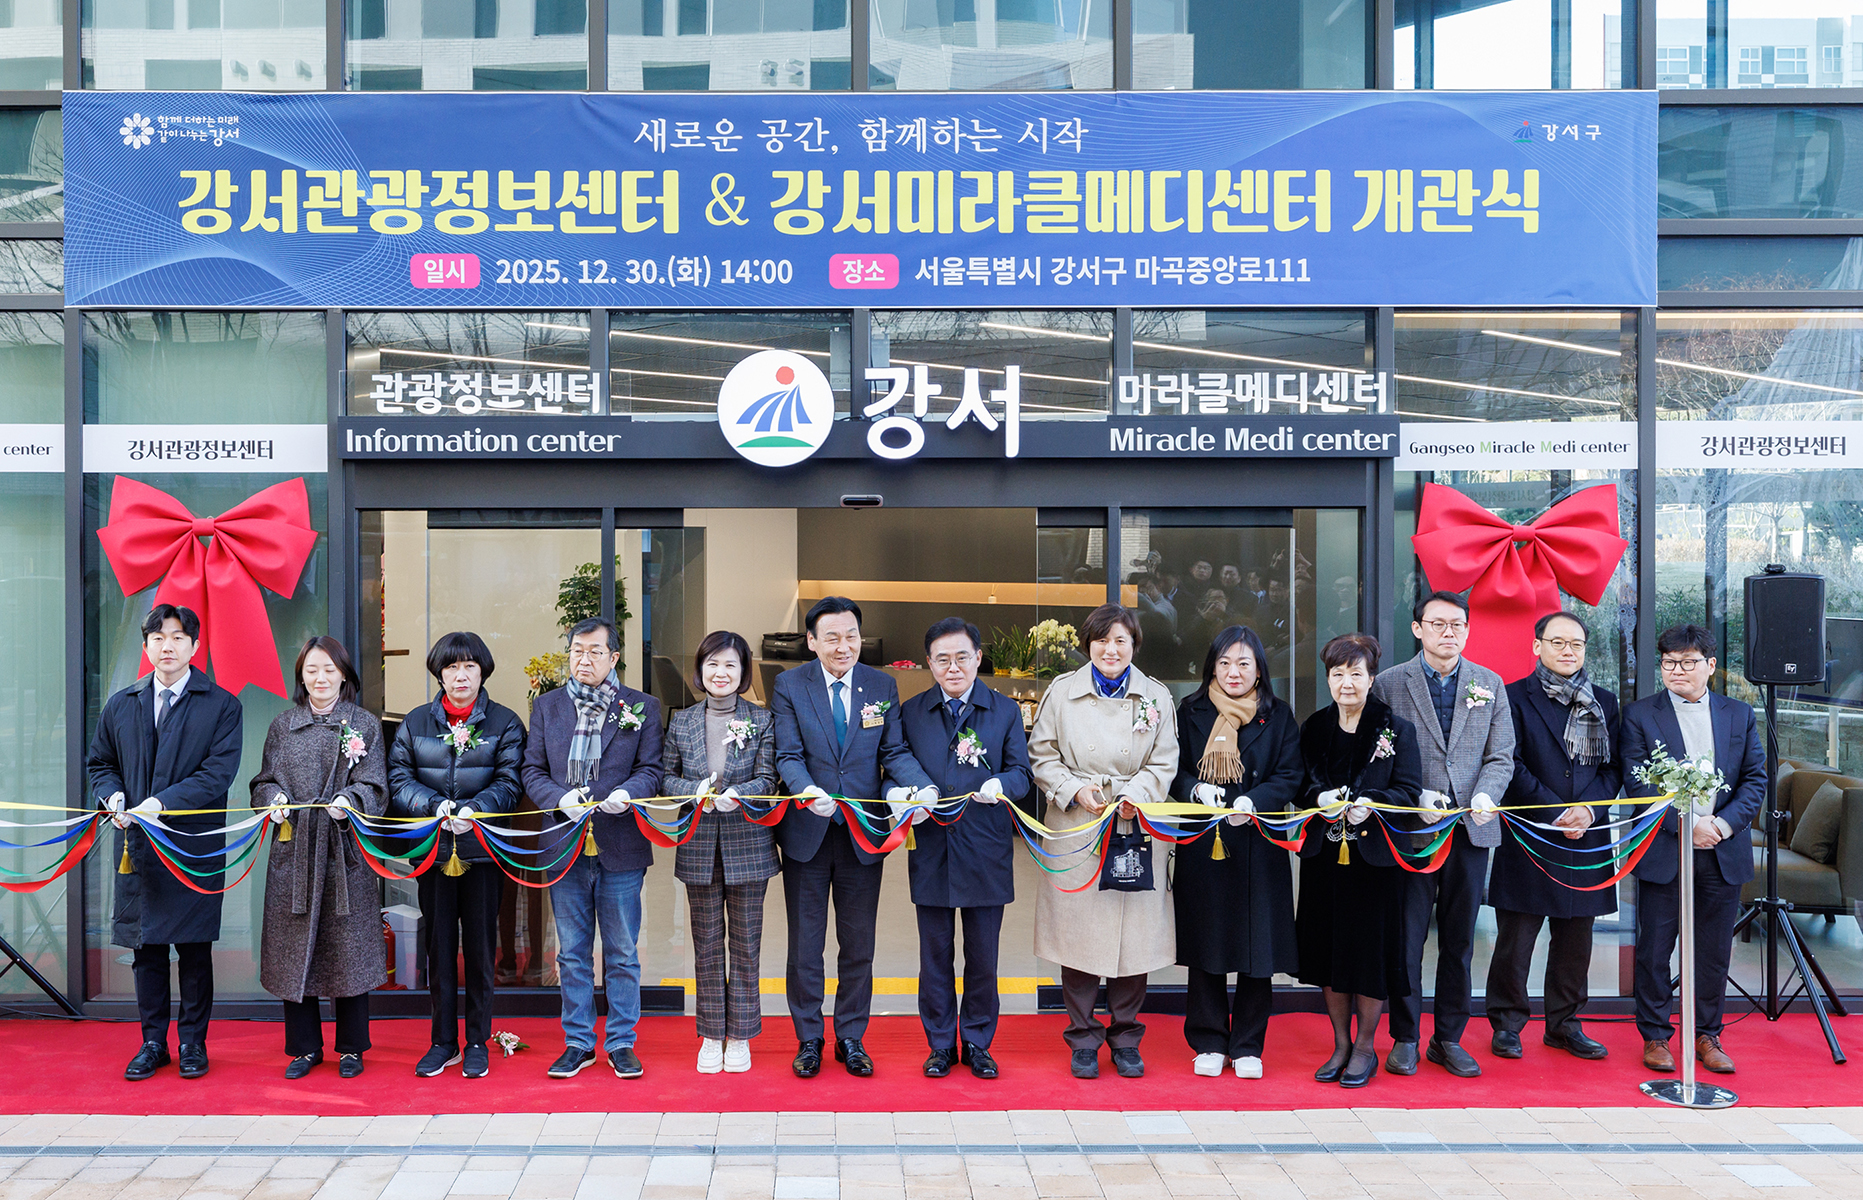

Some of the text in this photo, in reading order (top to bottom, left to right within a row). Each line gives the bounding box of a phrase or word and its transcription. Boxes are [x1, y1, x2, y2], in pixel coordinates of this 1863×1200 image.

[157, 115, 239, 129] 함께 더하는 미래
[157, 128, 240, 147] 같이 나누는 강서
[633, 116, 1090, 155] 새로운 공간, 함께하는 시작
[178, 169, 1540, 235] 강서관광정보센터 & 강서미라클메디센터 개관식
[423, 258, 466, 284] 일시
[495, 258, 568, 285] 2025.
[578, 259, 618, 285] 12.
[720, 259, 793, 285] 14:00
[842, 258, 886, 285] 장소
[914, 255, 1312, 287] 서울특별시 강서구 마곡중앙로111
[370, 372, 602, 415] 관광정보센터
[1118, 372, 1388, 416] 미라클메디센터
[863, 365, 1021, 459] 강서
[3, 444, 54, 456] center
[127, 439, 275, 461] 강서관광정보센터
[346, 427, 622, 453] Information center
[1110, 426, 1397, 452] Miracle Medi center
[1409, 439, 1631, 457] Gangseo Miracle Medi center
[1700, 435, 1848, 457] 강서관광정보센터
